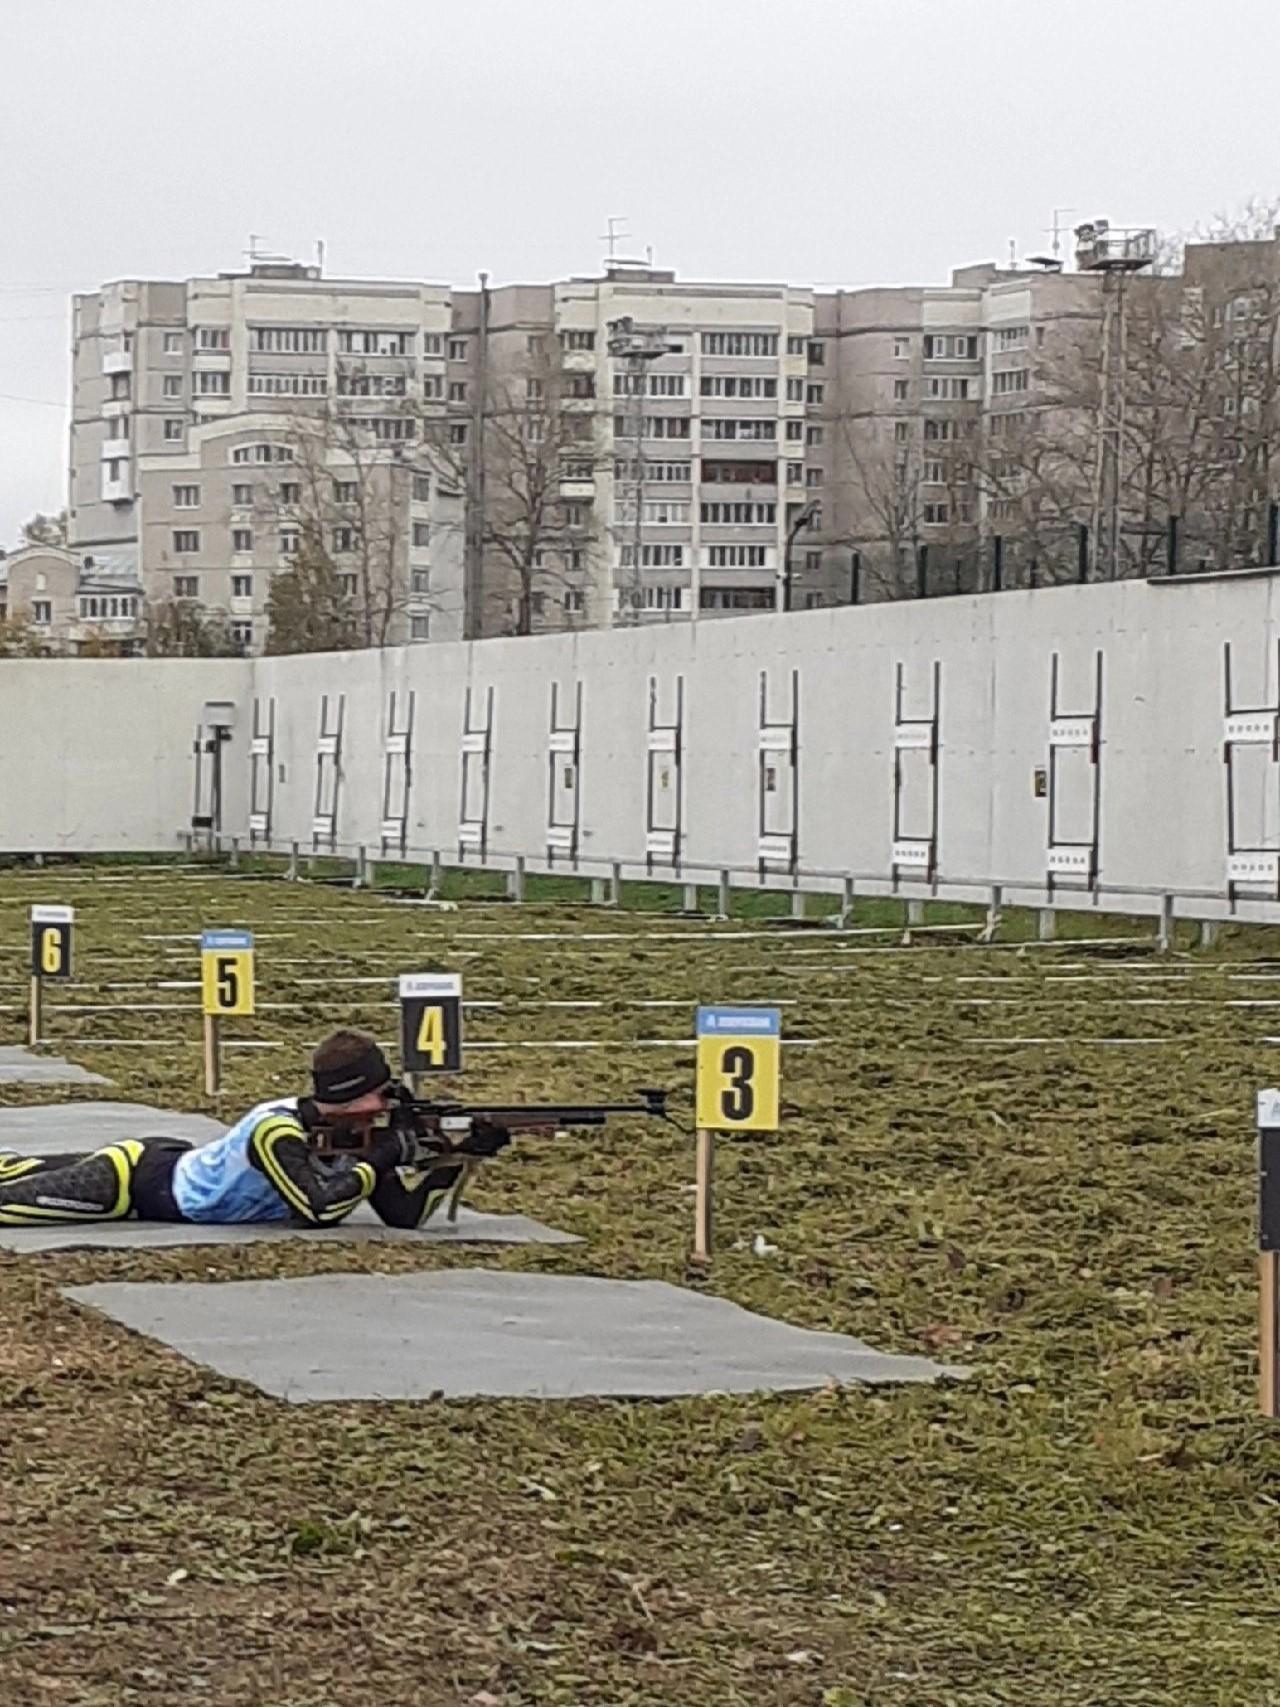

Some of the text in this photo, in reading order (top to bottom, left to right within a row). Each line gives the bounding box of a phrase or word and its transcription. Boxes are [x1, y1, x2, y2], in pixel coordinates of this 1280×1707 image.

[42, 927, 62, 973] 6
[216, 956, 239, 1008] 5
[416, 1005, 447, 1065] 4
[721, 1045, 755, 1121] 3
